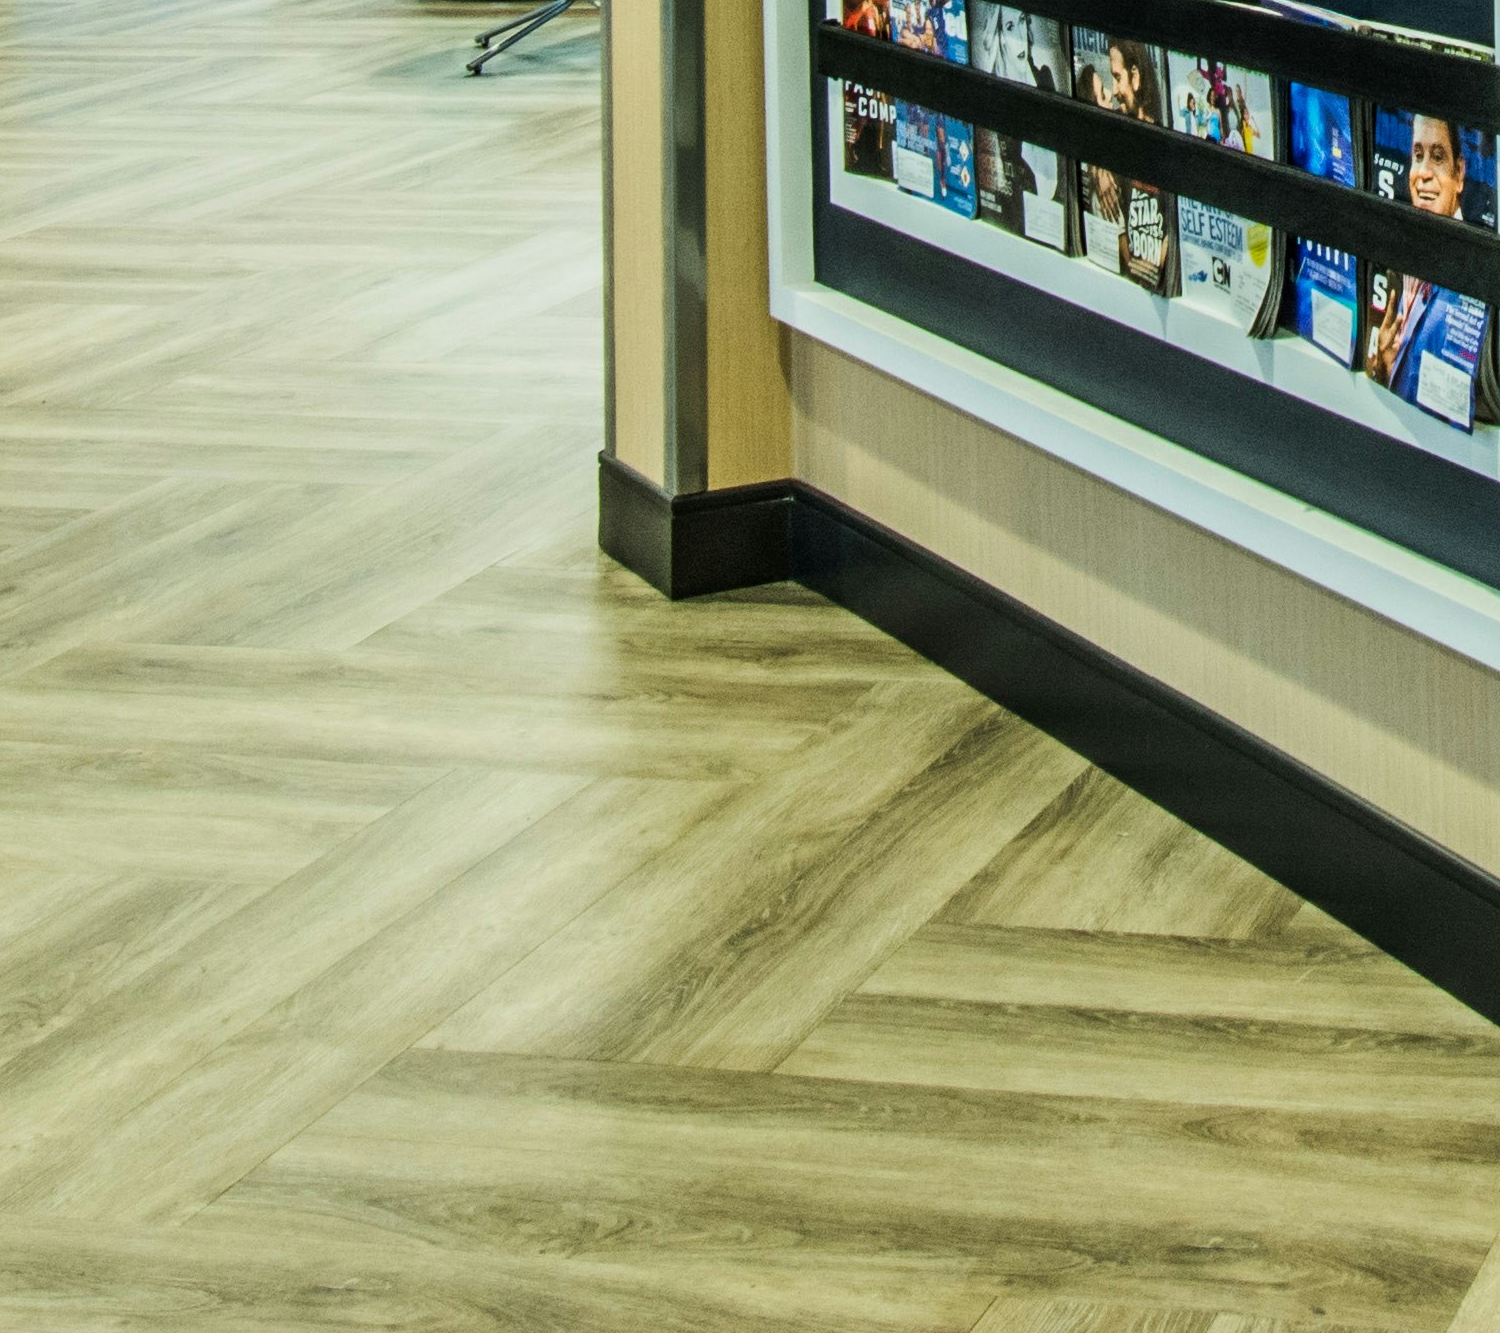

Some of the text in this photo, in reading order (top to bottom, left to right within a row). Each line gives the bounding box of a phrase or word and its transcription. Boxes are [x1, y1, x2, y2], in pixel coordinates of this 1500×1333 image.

[1374, 153, 1404, 175] Sammy
[1130, 197, 1159, 228] STAR
[1181, 207, 1205, 236] SELF
[1209, 214, 1243, 252] ESTEEM
[1130, 228, 1163, 267] BORN
